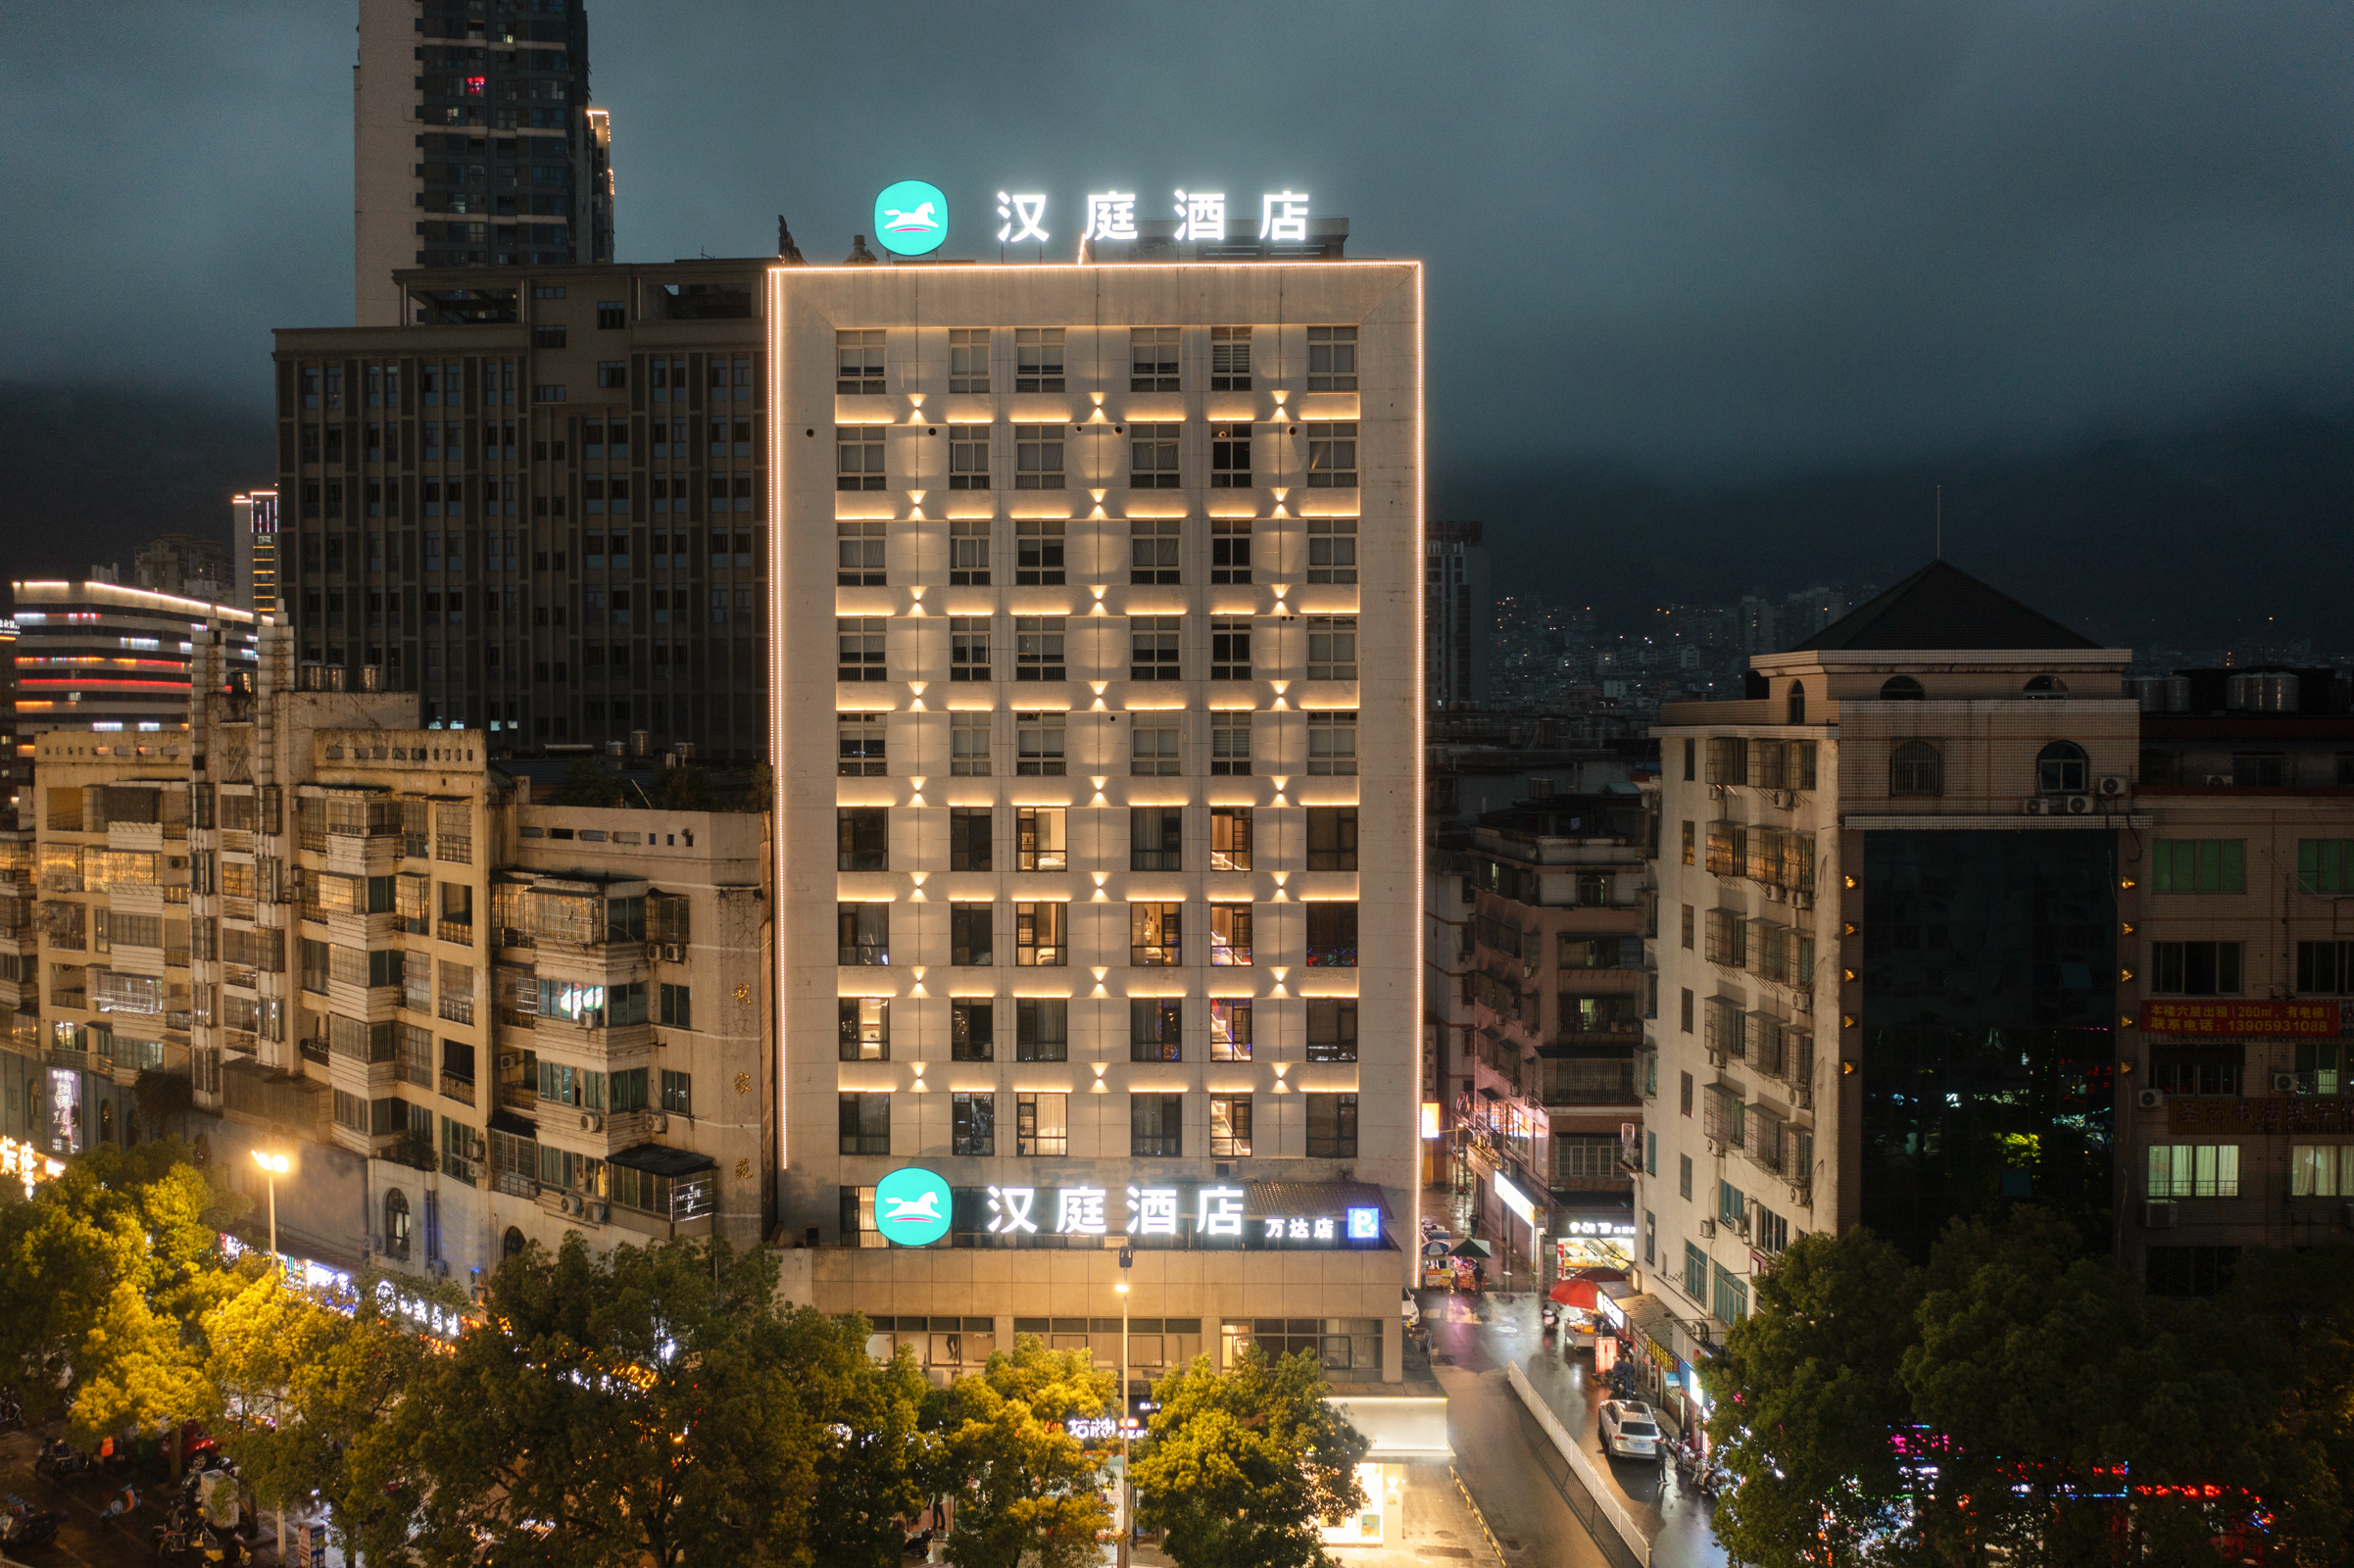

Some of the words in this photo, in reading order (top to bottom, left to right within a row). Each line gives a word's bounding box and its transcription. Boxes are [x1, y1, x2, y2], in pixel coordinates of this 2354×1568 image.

[997, 189, 1309, 242] 汉庭酒店
[987, 1186, 1244, 1235] 汉庭酒店
[1264, 1217, 1335, 1239] 万达店
[1354, 1211, 1372, 1233] P
